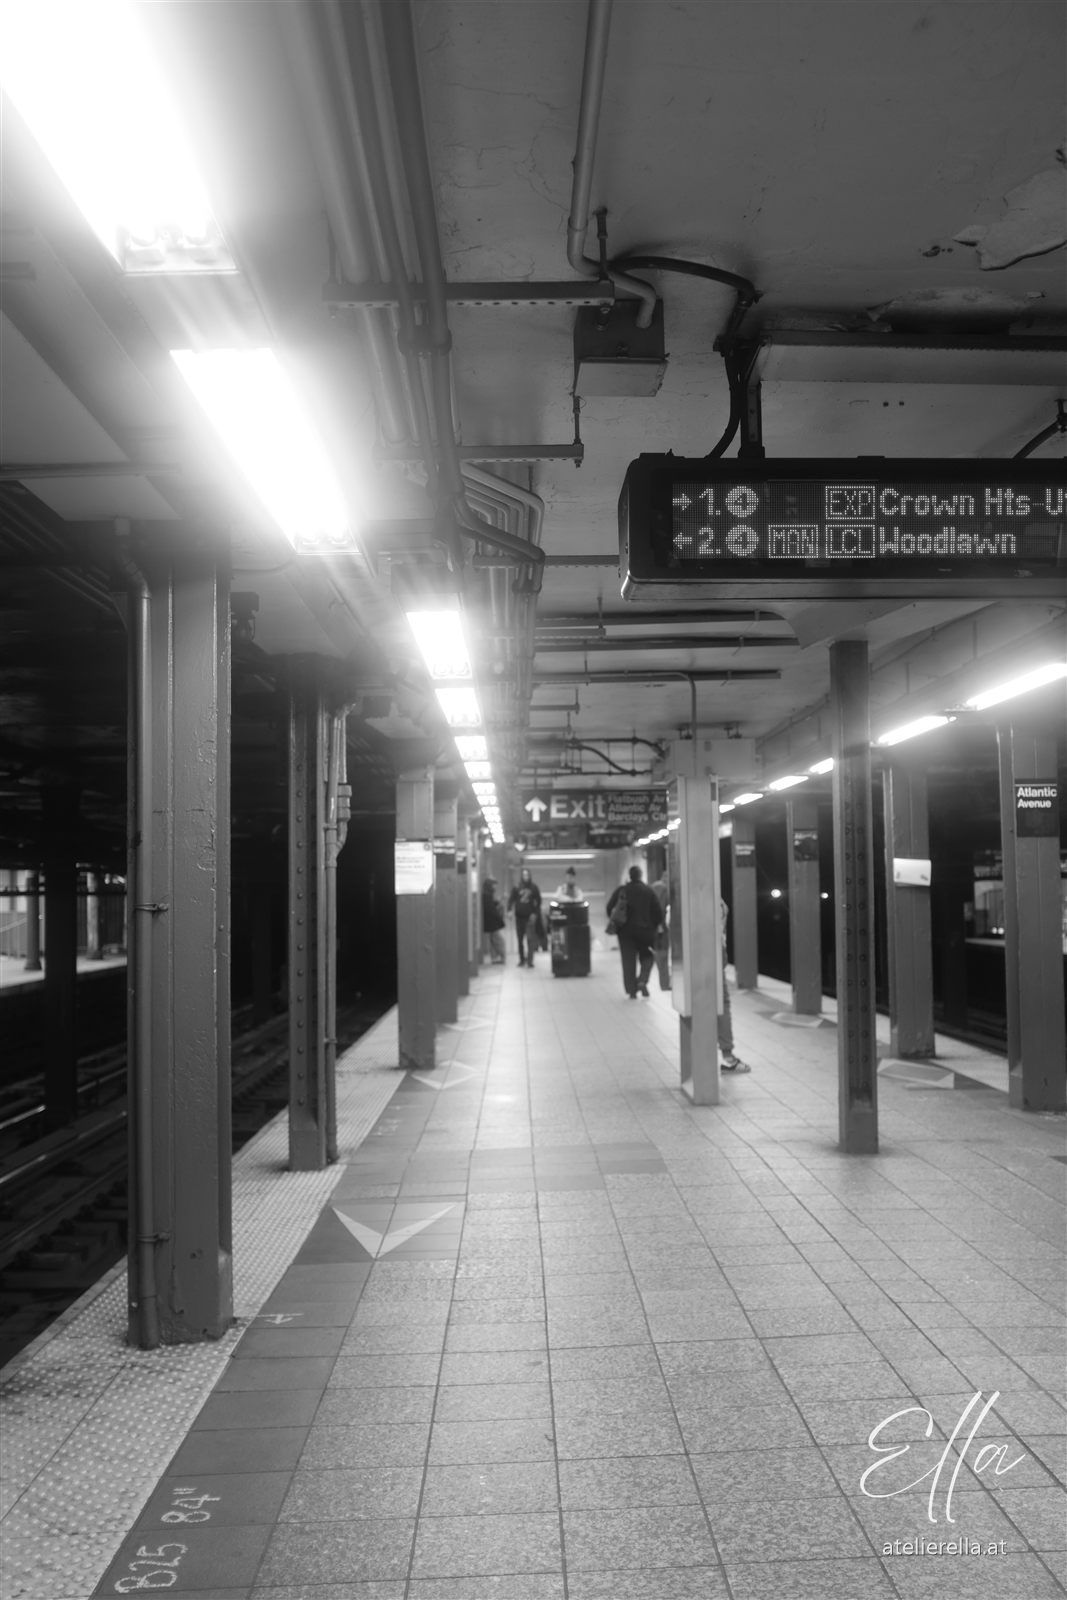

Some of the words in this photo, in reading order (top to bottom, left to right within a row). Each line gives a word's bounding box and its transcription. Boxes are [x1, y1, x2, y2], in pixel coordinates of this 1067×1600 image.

[830, 490, 871, 514] EXP
[880, 488, 975, 516] Crown
[985, 488, 1067, 516] Hts-U
[773, 530, 814, 554] MAN
[830, 530, 871, 554] LCL
[879, 527, 1017, 554] Woodlawn
[1017, 787, 1057, 798] Atlantic
[1017, 798, 1052, 808] Avenue
[551, 795, 606, 818] Exit
